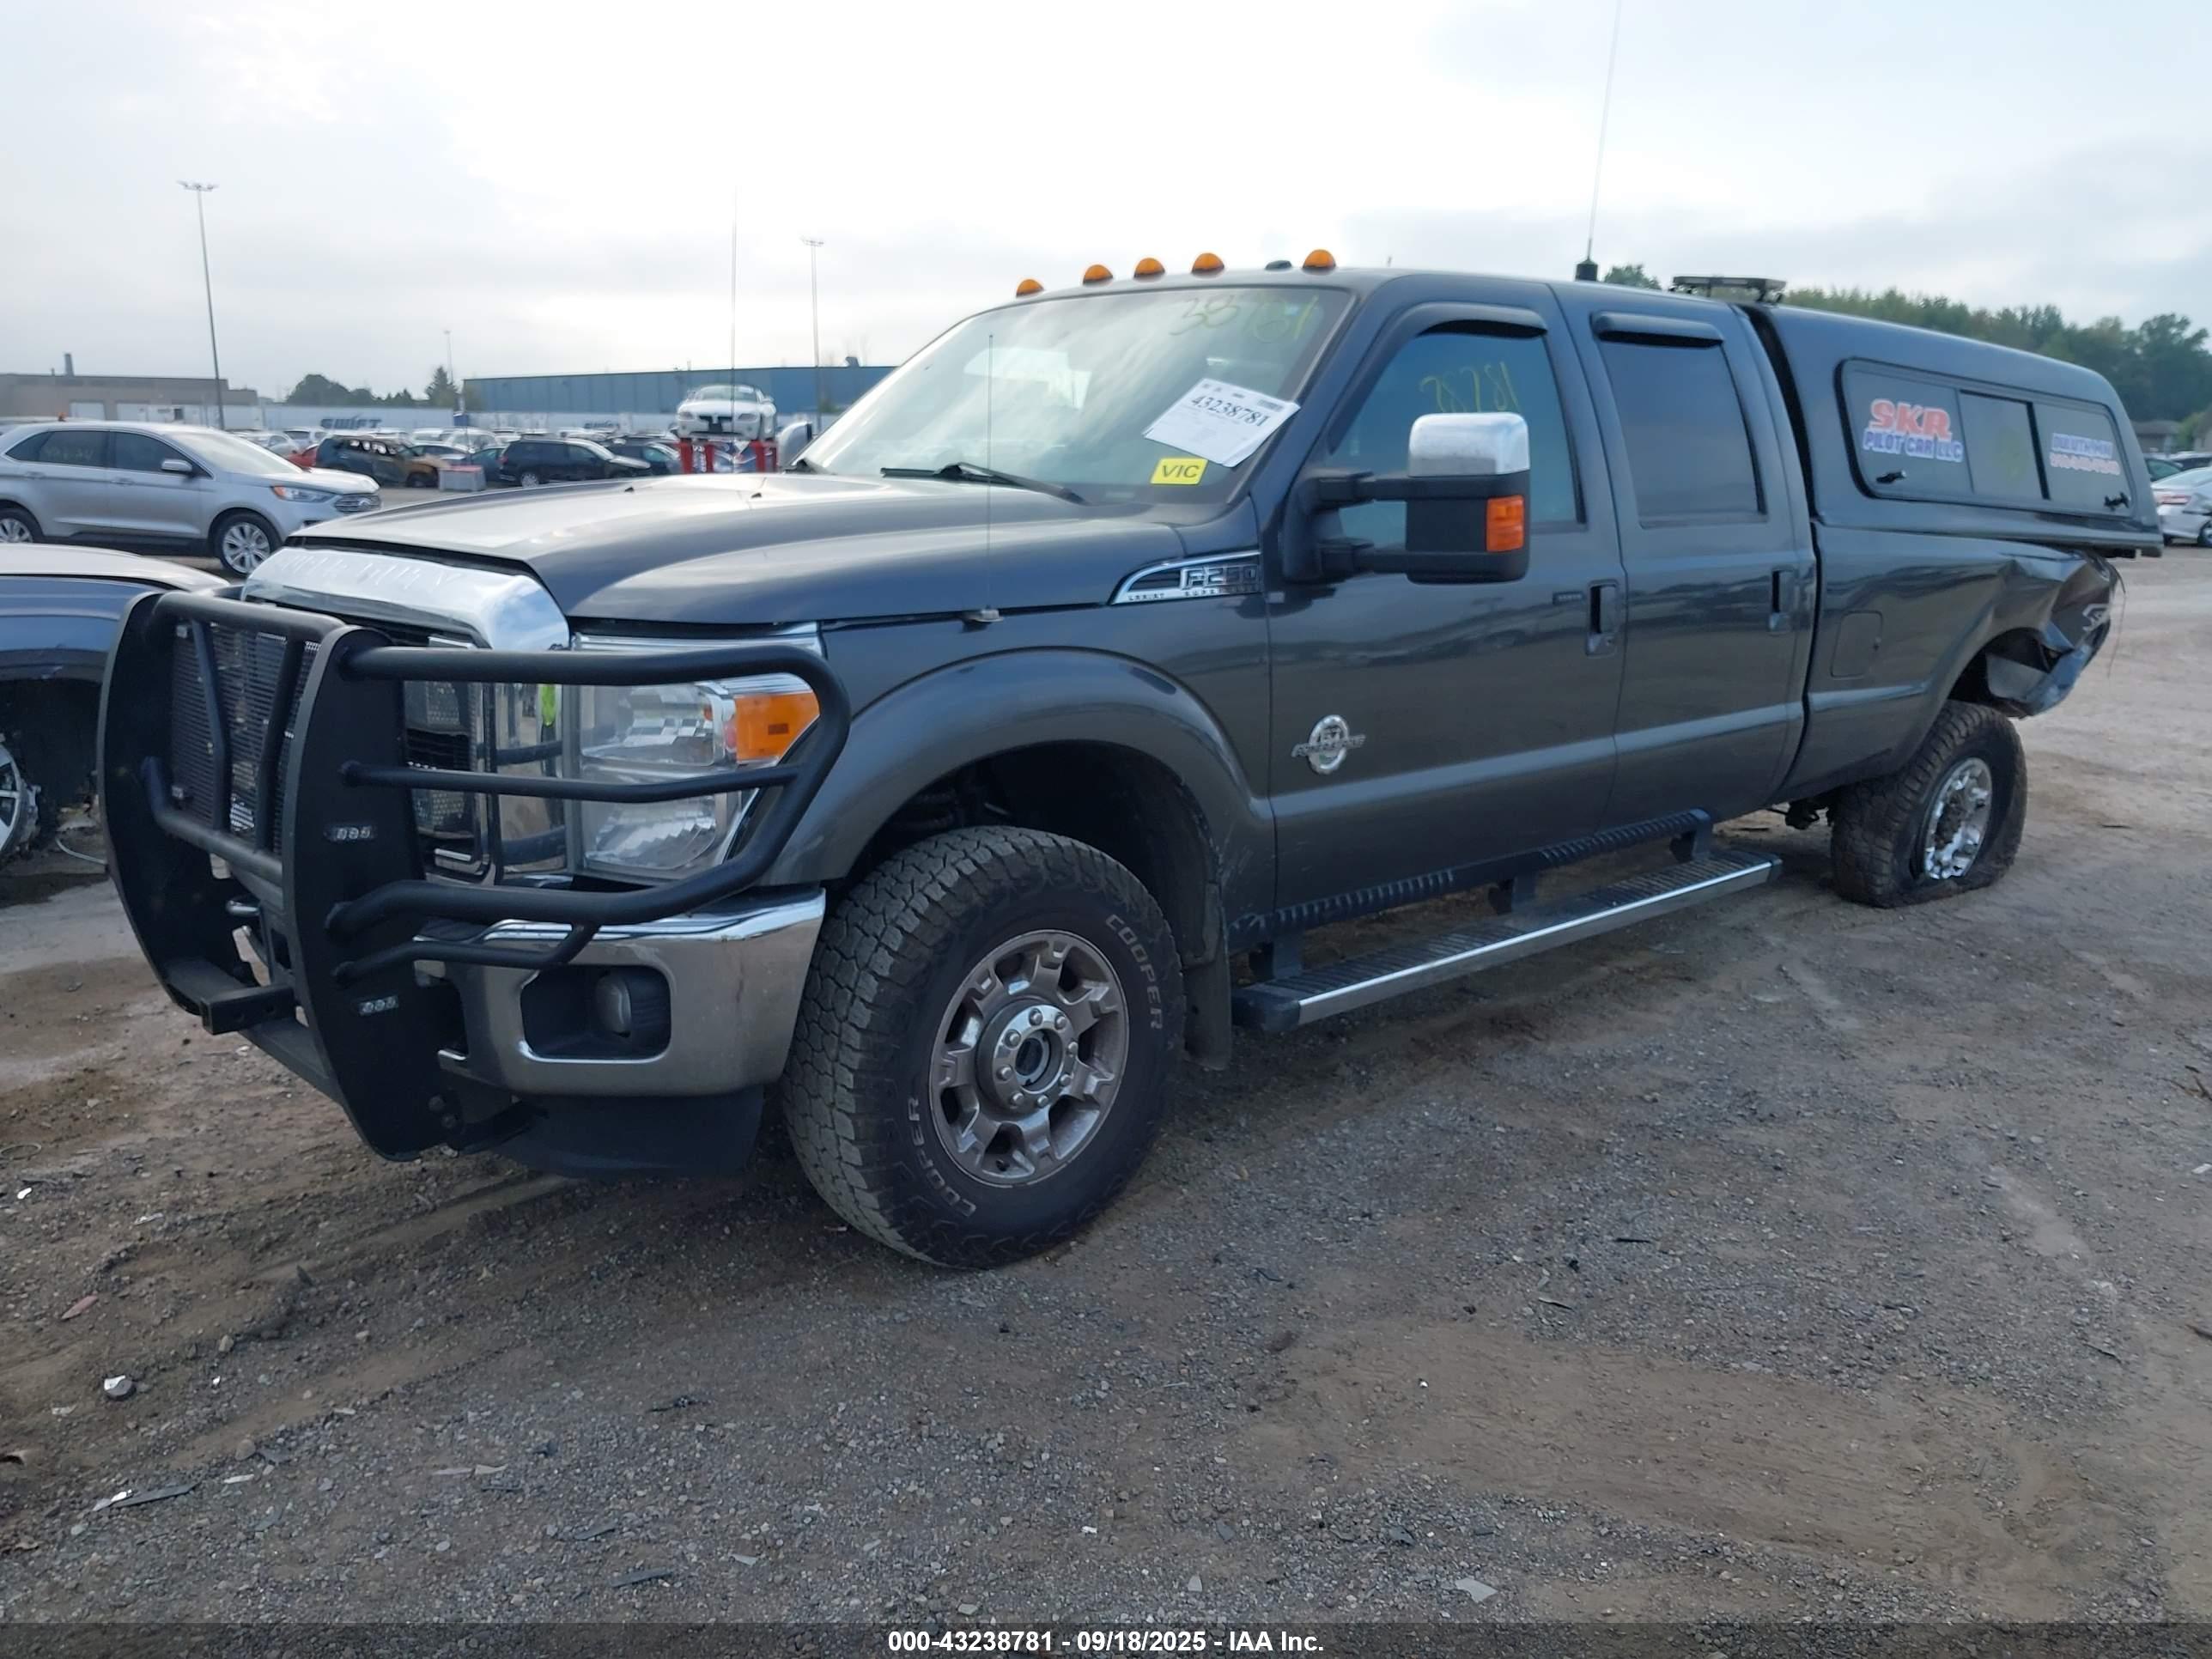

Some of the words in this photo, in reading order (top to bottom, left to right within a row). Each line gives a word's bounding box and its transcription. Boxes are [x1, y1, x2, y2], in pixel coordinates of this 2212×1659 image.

[1191, 396, 1271, 426] 43238781
[1869, 398, 1953, 442] SKR
[1863, 428, 1904, 454] PILOT
[1161, 465, 1200, 478] VIC
[1105, 914, 1164, 1029] COOPER
